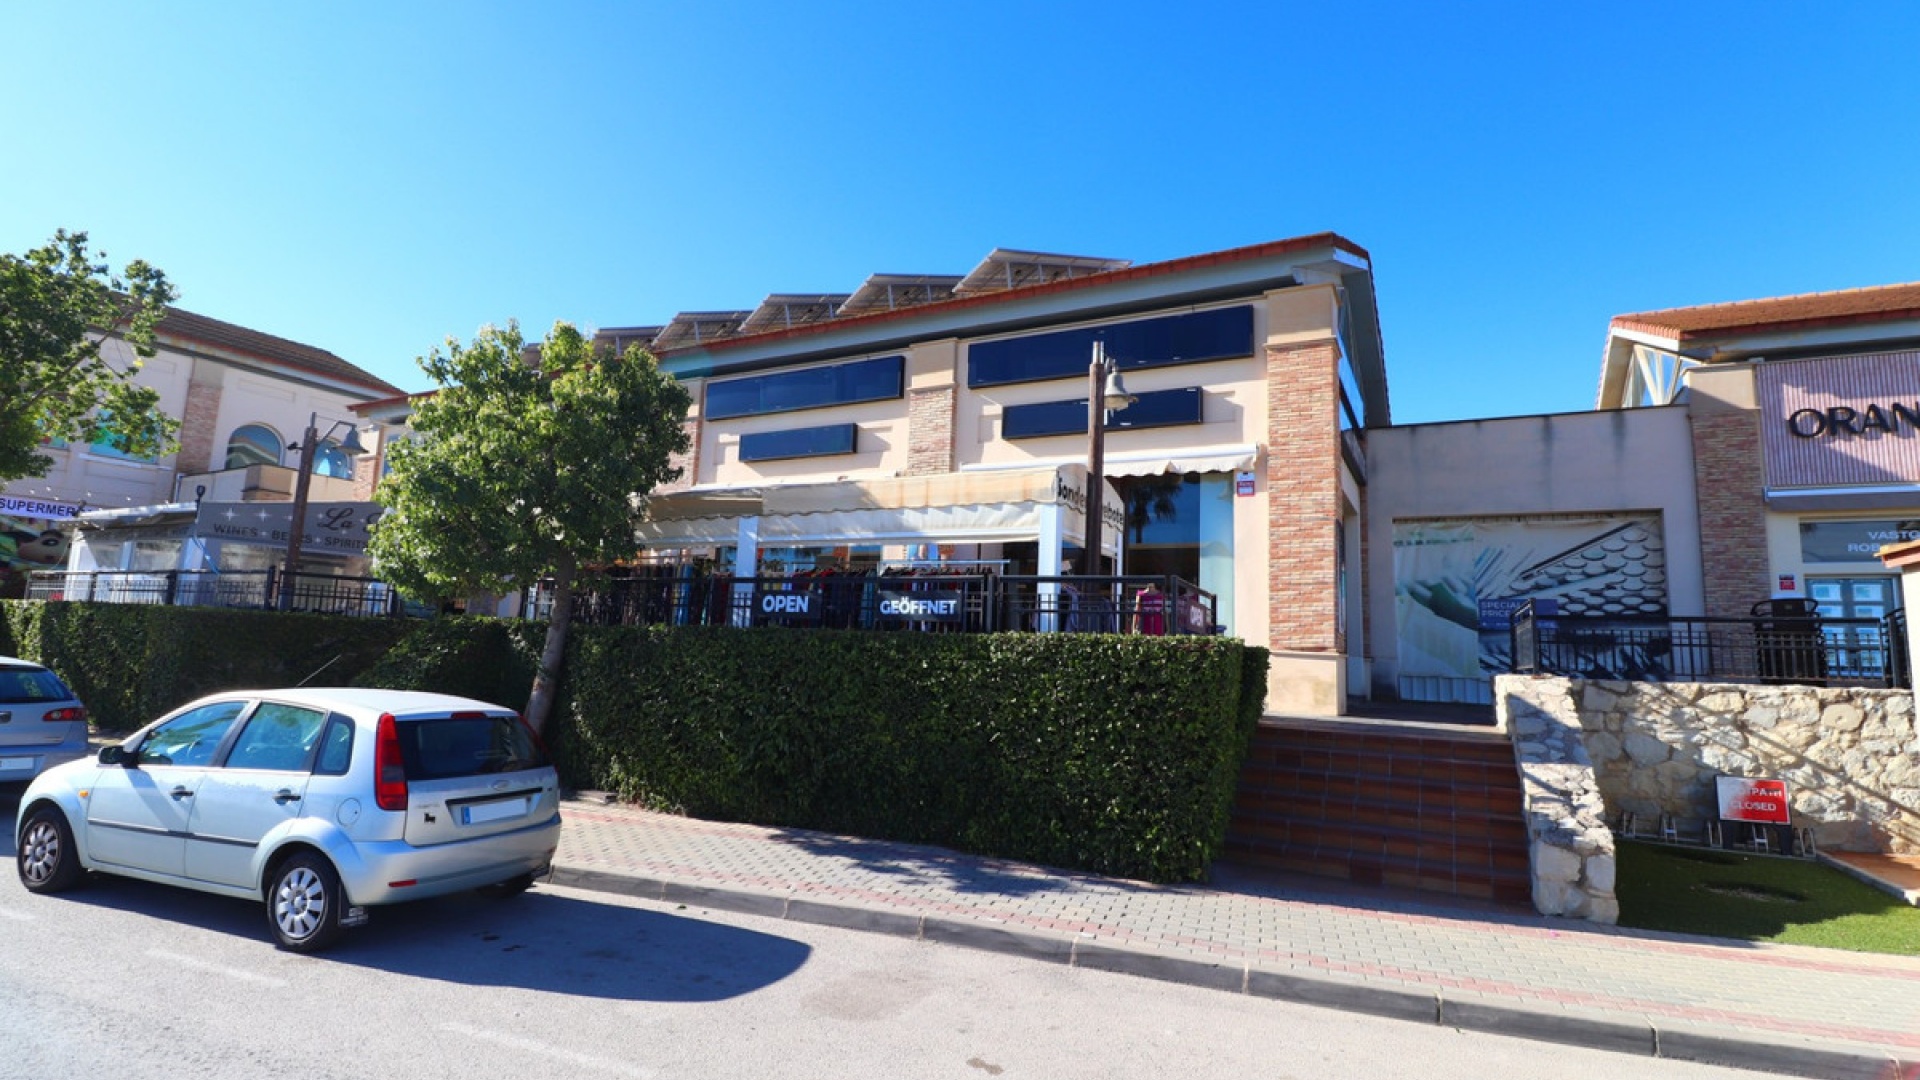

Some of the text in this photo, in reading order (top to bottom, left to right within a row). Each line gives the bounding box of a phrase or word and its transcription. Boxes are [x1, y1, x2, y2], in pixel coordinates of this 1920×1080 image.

[1788, 402, 1920, 438] ORAN
[0, 498, 80, 518] SUPERMER
[214, 523, 258, 537] WINES
[271, 529, 312, 544] BES
[762, 595, 809, 613] OPEN
[880, 597, 957, 615] GEÖFFNET
